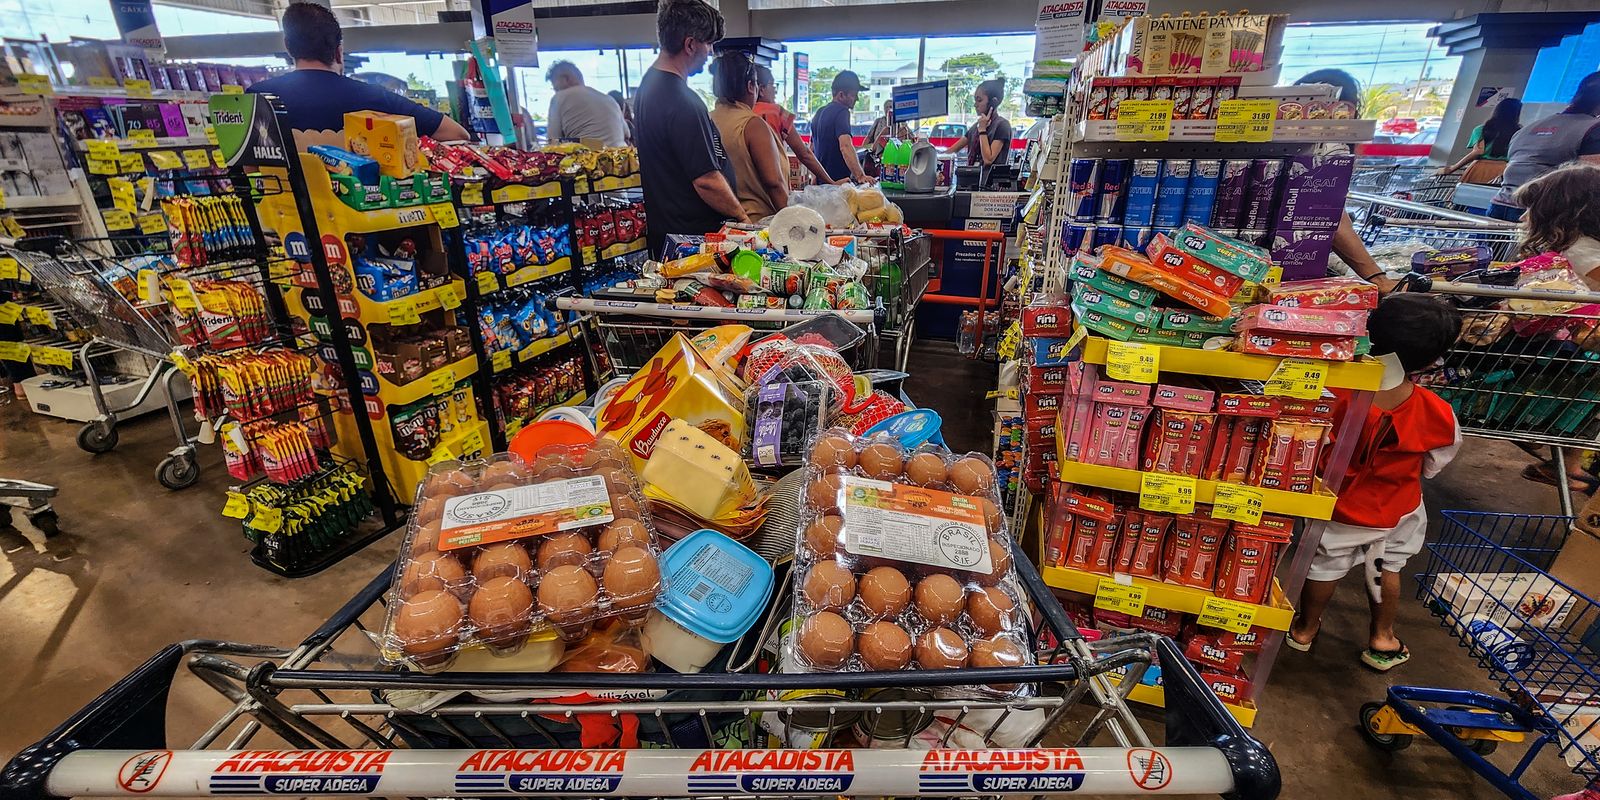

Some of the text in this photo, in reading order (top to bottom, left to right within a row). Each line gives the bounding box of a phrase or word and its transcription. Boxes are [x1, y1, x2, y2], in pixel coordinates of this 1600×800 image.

[1041, 2, 1084, 14] ATACADISTA
[1105, 1, 1146, 10] ATACADISTA
[496, 20, 533, 29] ATACADISTA
[1150, 20, 1206, 32] PANTENE
[1210, 16, 1266, 29] PANTENE
[1134, 30, 1144, 64] PANTENE
[213, 111, 244, 124] Trident
[1104, 182, 1120, 190] Red
[1302, 177, 1338, 189] AÇAÍ
[1283, 188, 1300, 222] Red Bull
[1246, 201, 1260, 229] Red Bull
[1185, 237, 1206, 250] Fini
[325, 245, 342, 260] m
[1284, 251, 1318, 262] AÇAÍ
[1164, 253, 1182, 266] Fini
[1076, 266, 1096, 278] Fini
[306, 296, 323, 310] m
[1082, 292, 1102, 303] Fini
[1036, 314, 1056, 324] Fini
[1088, 313, 1102, 322] Fini
[1169, 313, 1189, 324] Fini
[1264, 310, 1288, 321] Fini
[314, 321, 331, 336] m
[1251, 336, 1274, 346] Fini
[1050, 343, 1064, 353] Fin
[353, 351, 368, 364] m
[1043, 372, 1062, 380] Fini
[1038, 397, 1056, 408] Fini
[1108, 410, 1124, 418] Fini
[1041, 426, 1055, 435] Fin
[1168, 421, 1185, 430] Fini
[634, 416, 668, 456] Bauducco
[1247, 499, 1262, 508] 8.99
[462, 506, 501, 520] BRASIL
[942, 528, 976, 546] BRASIL
[960, 522, 988, 554] AGRICULTURA
[942, 542, 980, 553] INSPECIONADO
[1242, 548, 1258, 556] Fini
[953, 556, 973, 565] S.I.F.
[1146, 608, 1166, 618] Fini
[1235, 632, 1256, 642] Fini
[1203, 645, 1226, 658] Fini
[1213, 682, 1236, 694] Fini
[214, 750, 392, 772] ATACADISTA
[459, 750, 624, 772] ATACADISTA
[688, 750, 854, 772] ATACADISTA
[919, 749, 1084, 771] ATACADISTA
[274, 778, 368, 793] SUPER ADEGA
[519, 777, 611, 792] SUPER ADEGA
[751, 776, 842, 791] SUPER ADEGA
[982, 776, 1073, 790] SUPER ADEGA
